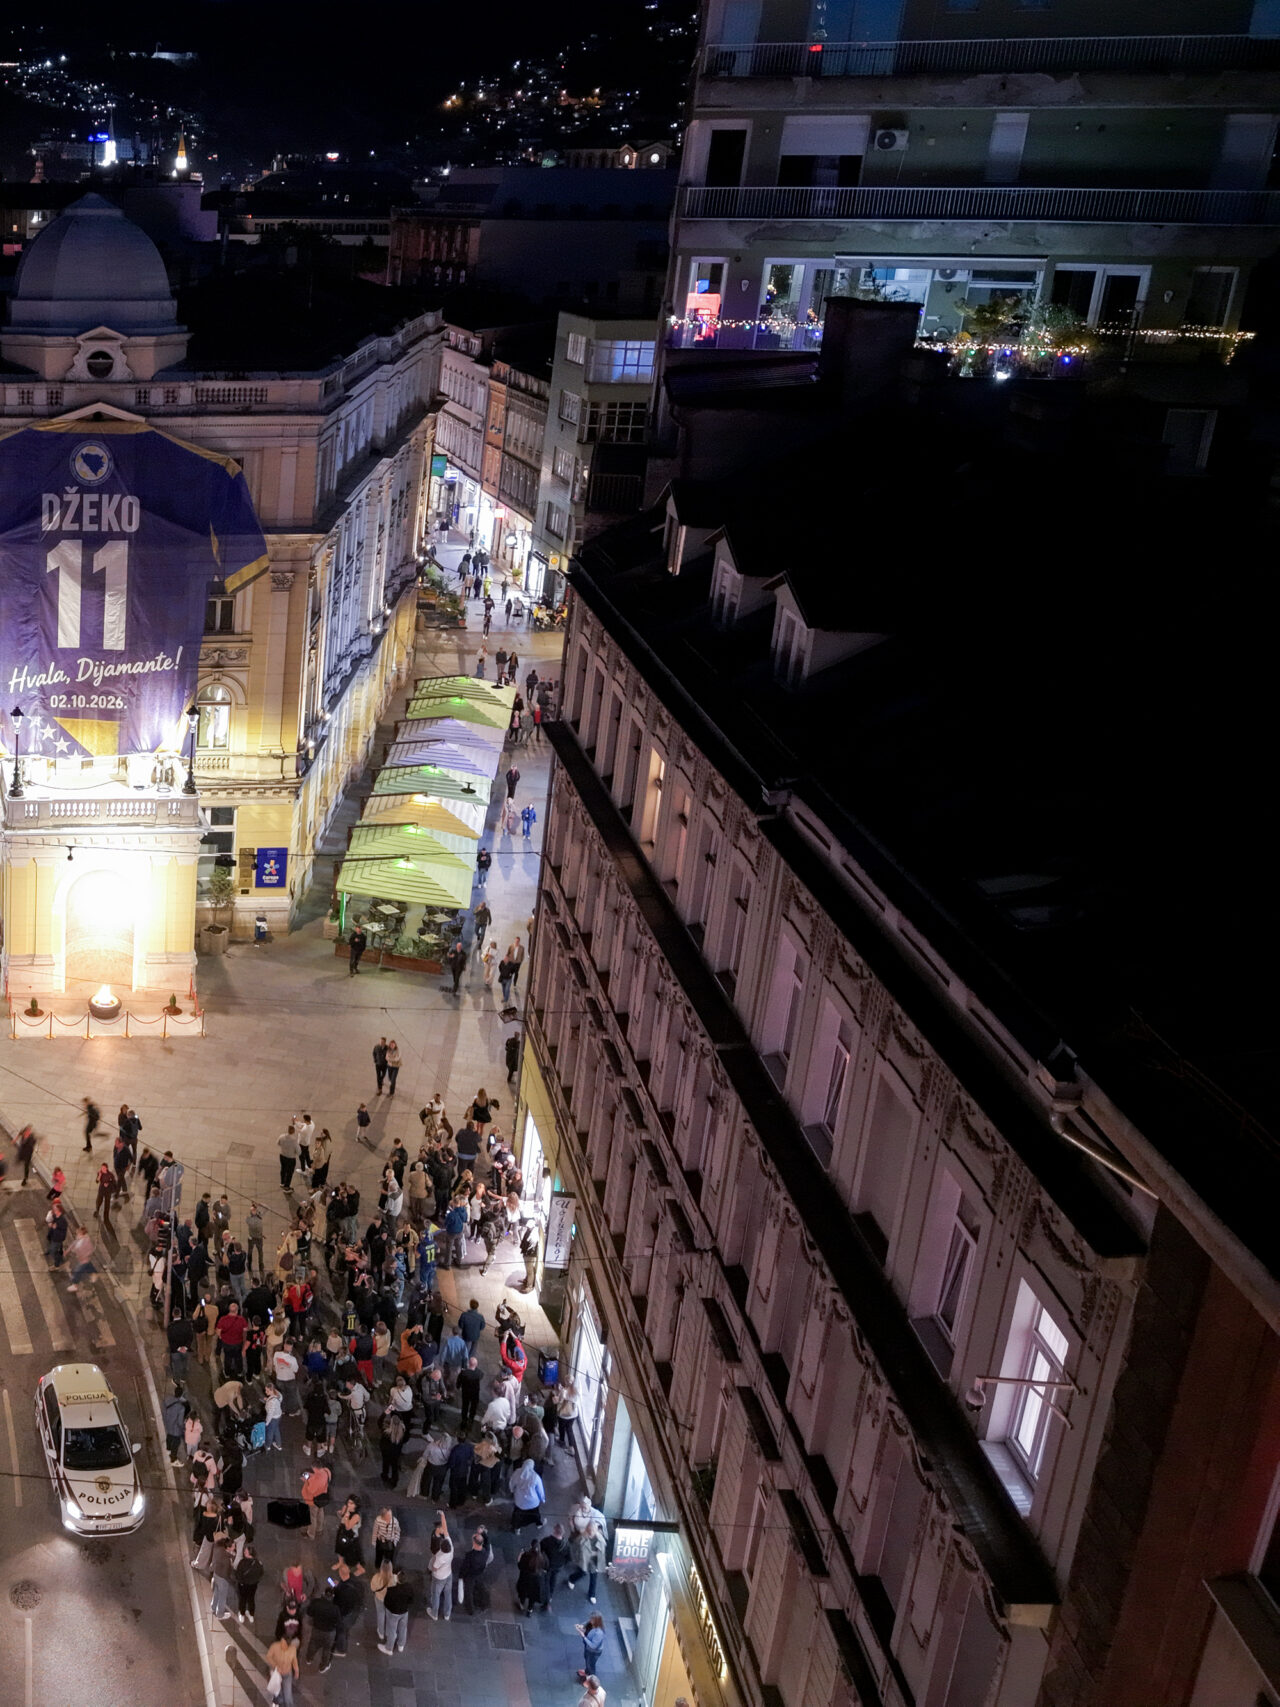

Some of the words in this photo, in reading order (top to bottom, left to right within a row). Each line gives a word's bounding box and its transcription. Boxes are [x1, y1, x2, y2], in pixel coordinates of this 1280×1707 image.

[42, 486, 140, 532] DŽEKO
[46, 539, 128, 650] 11
[9, 662, 70, 694] Hvala,
[75, 646, 183, 686] Dijamante!
[50, 694, 128, 709] 02.10.2026.
[66, 1392, 107, 1401] POLICIJA
[78, 1488, 131, 1505] POLICIJA
[617, 1533, 649, 1547] FINE
[616, 1545, 648, 1558] FOOD
